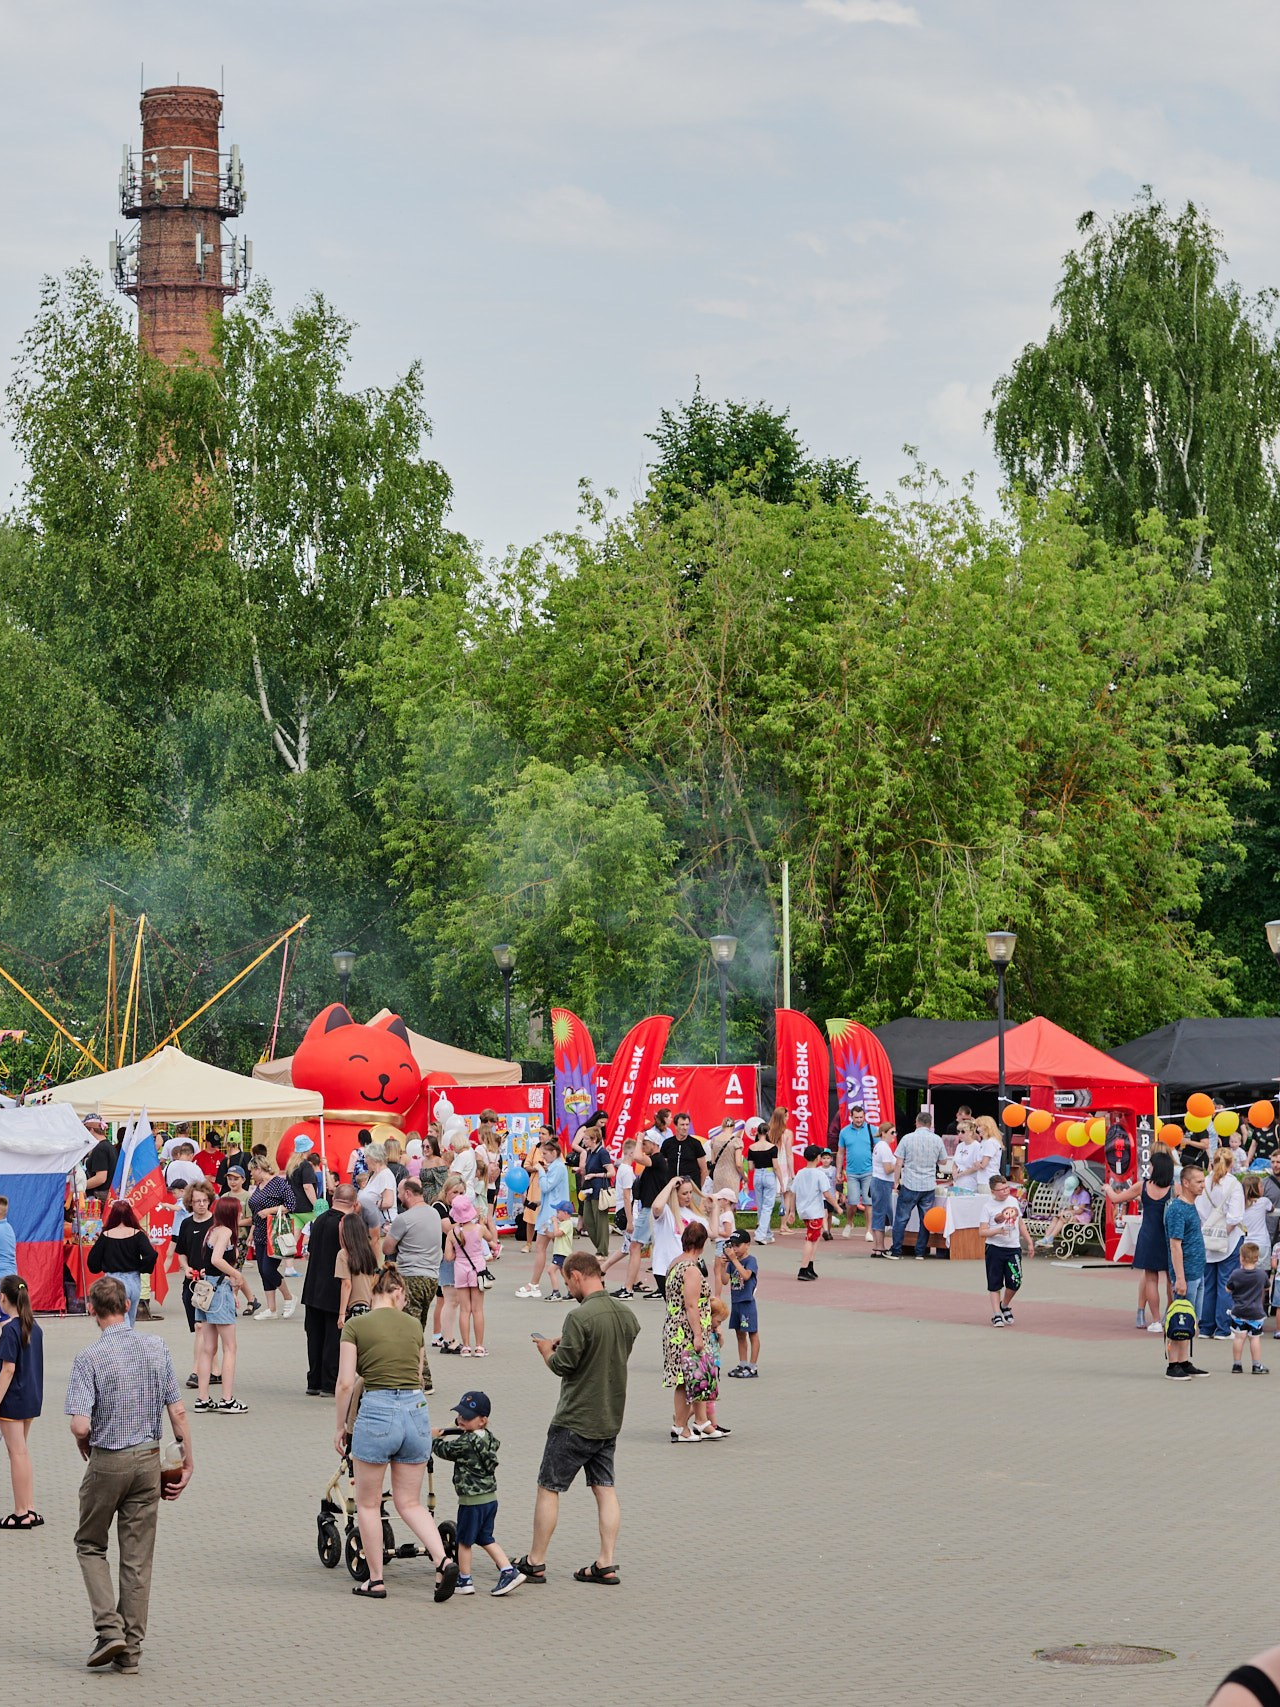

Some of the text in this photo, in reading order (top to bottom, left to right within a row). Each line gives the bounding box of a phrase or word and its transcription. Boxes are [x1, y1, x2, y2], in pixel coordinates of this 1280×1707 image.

[610, 1045, 646, 1161] Альфа Банк
[792, 1041, 812, 1156] Альфа Банк
[1141, 1134, 1150, 1177] BOX
